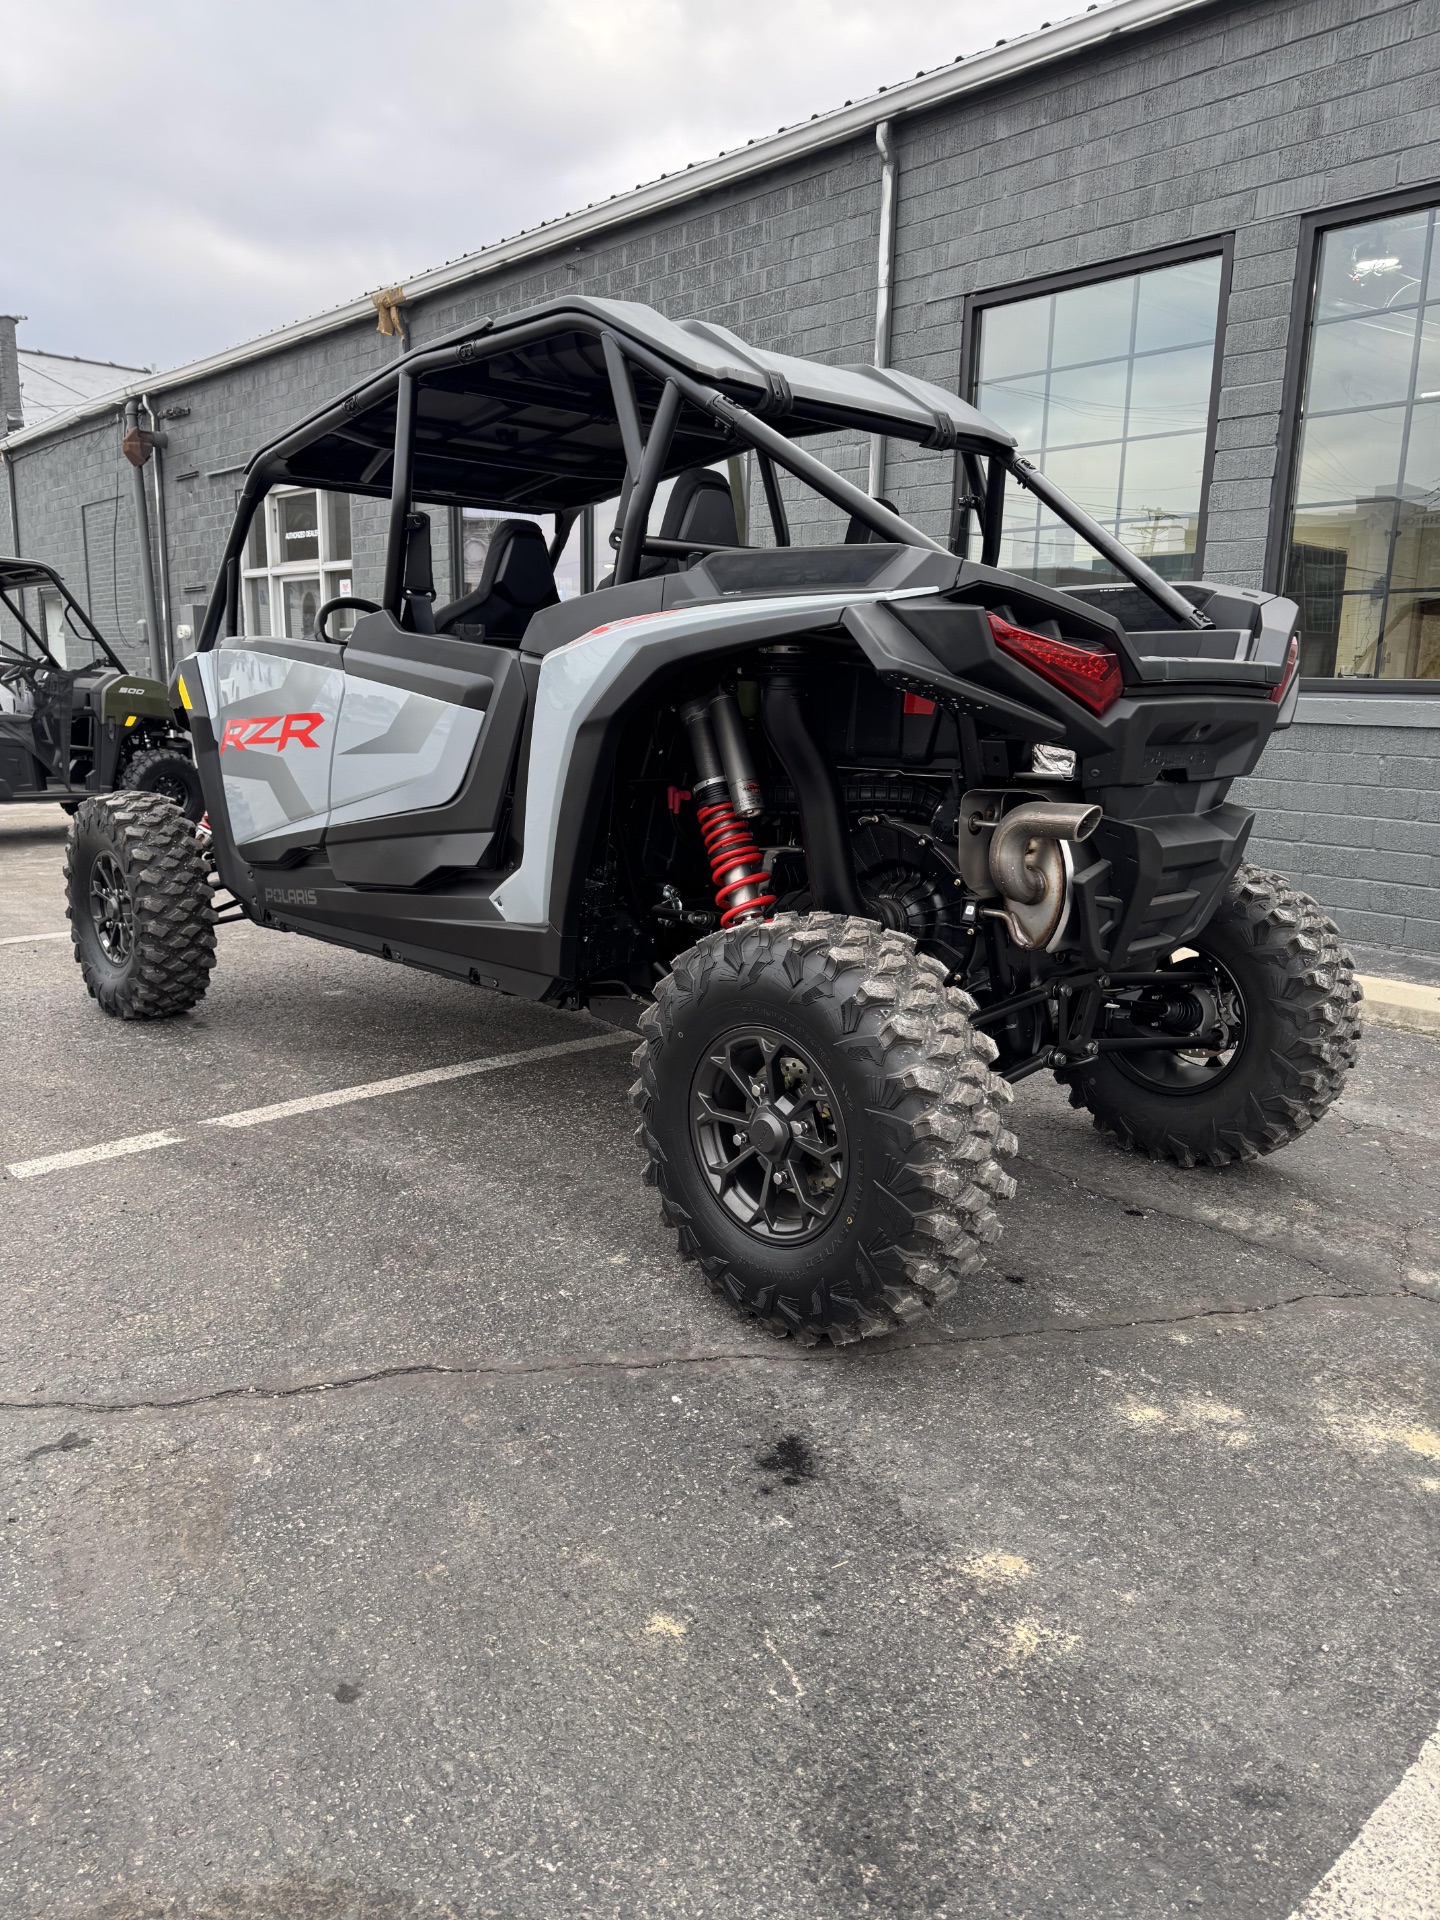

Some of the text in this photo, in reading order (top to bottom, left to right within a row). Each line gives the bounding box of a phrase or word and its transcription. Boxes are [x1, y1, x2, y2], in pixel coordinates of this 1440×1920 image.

[118, 686, 146, 696] 500
[220, 713, 325, 755] RZR
[264, 887, 318, 905] POLARIS
